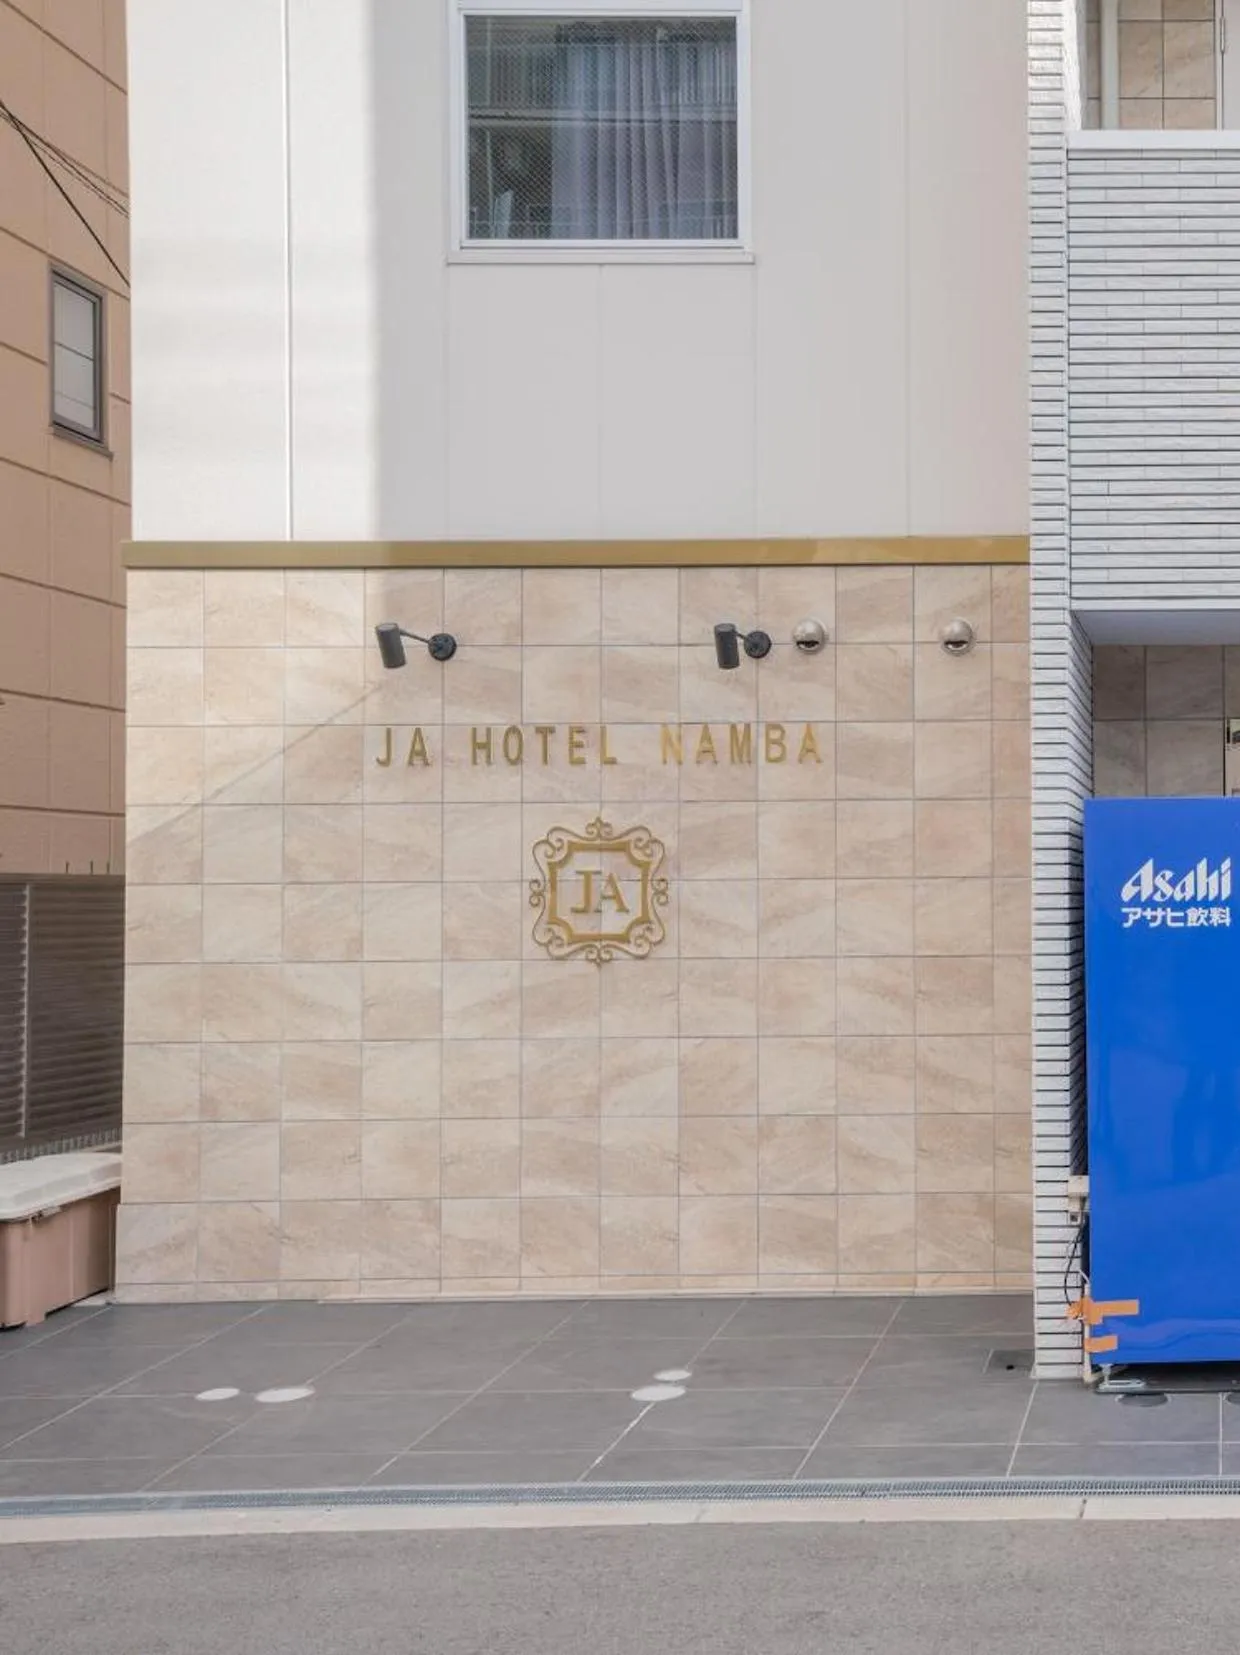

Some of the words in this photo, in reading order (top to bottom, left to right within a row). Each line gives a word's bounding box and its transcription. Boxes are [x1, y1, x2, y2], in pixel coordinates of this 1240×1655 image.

[375, 726, 431, 767] JA
[470, 725, 618, 766] HOTEL
[660, 722, 823, 766] NAMBA
[570, 869, 630, 914] JA
[1120, 857, 1231, 902] Asahi
[1120, 907, 1231, 928] アサヒ飲料
